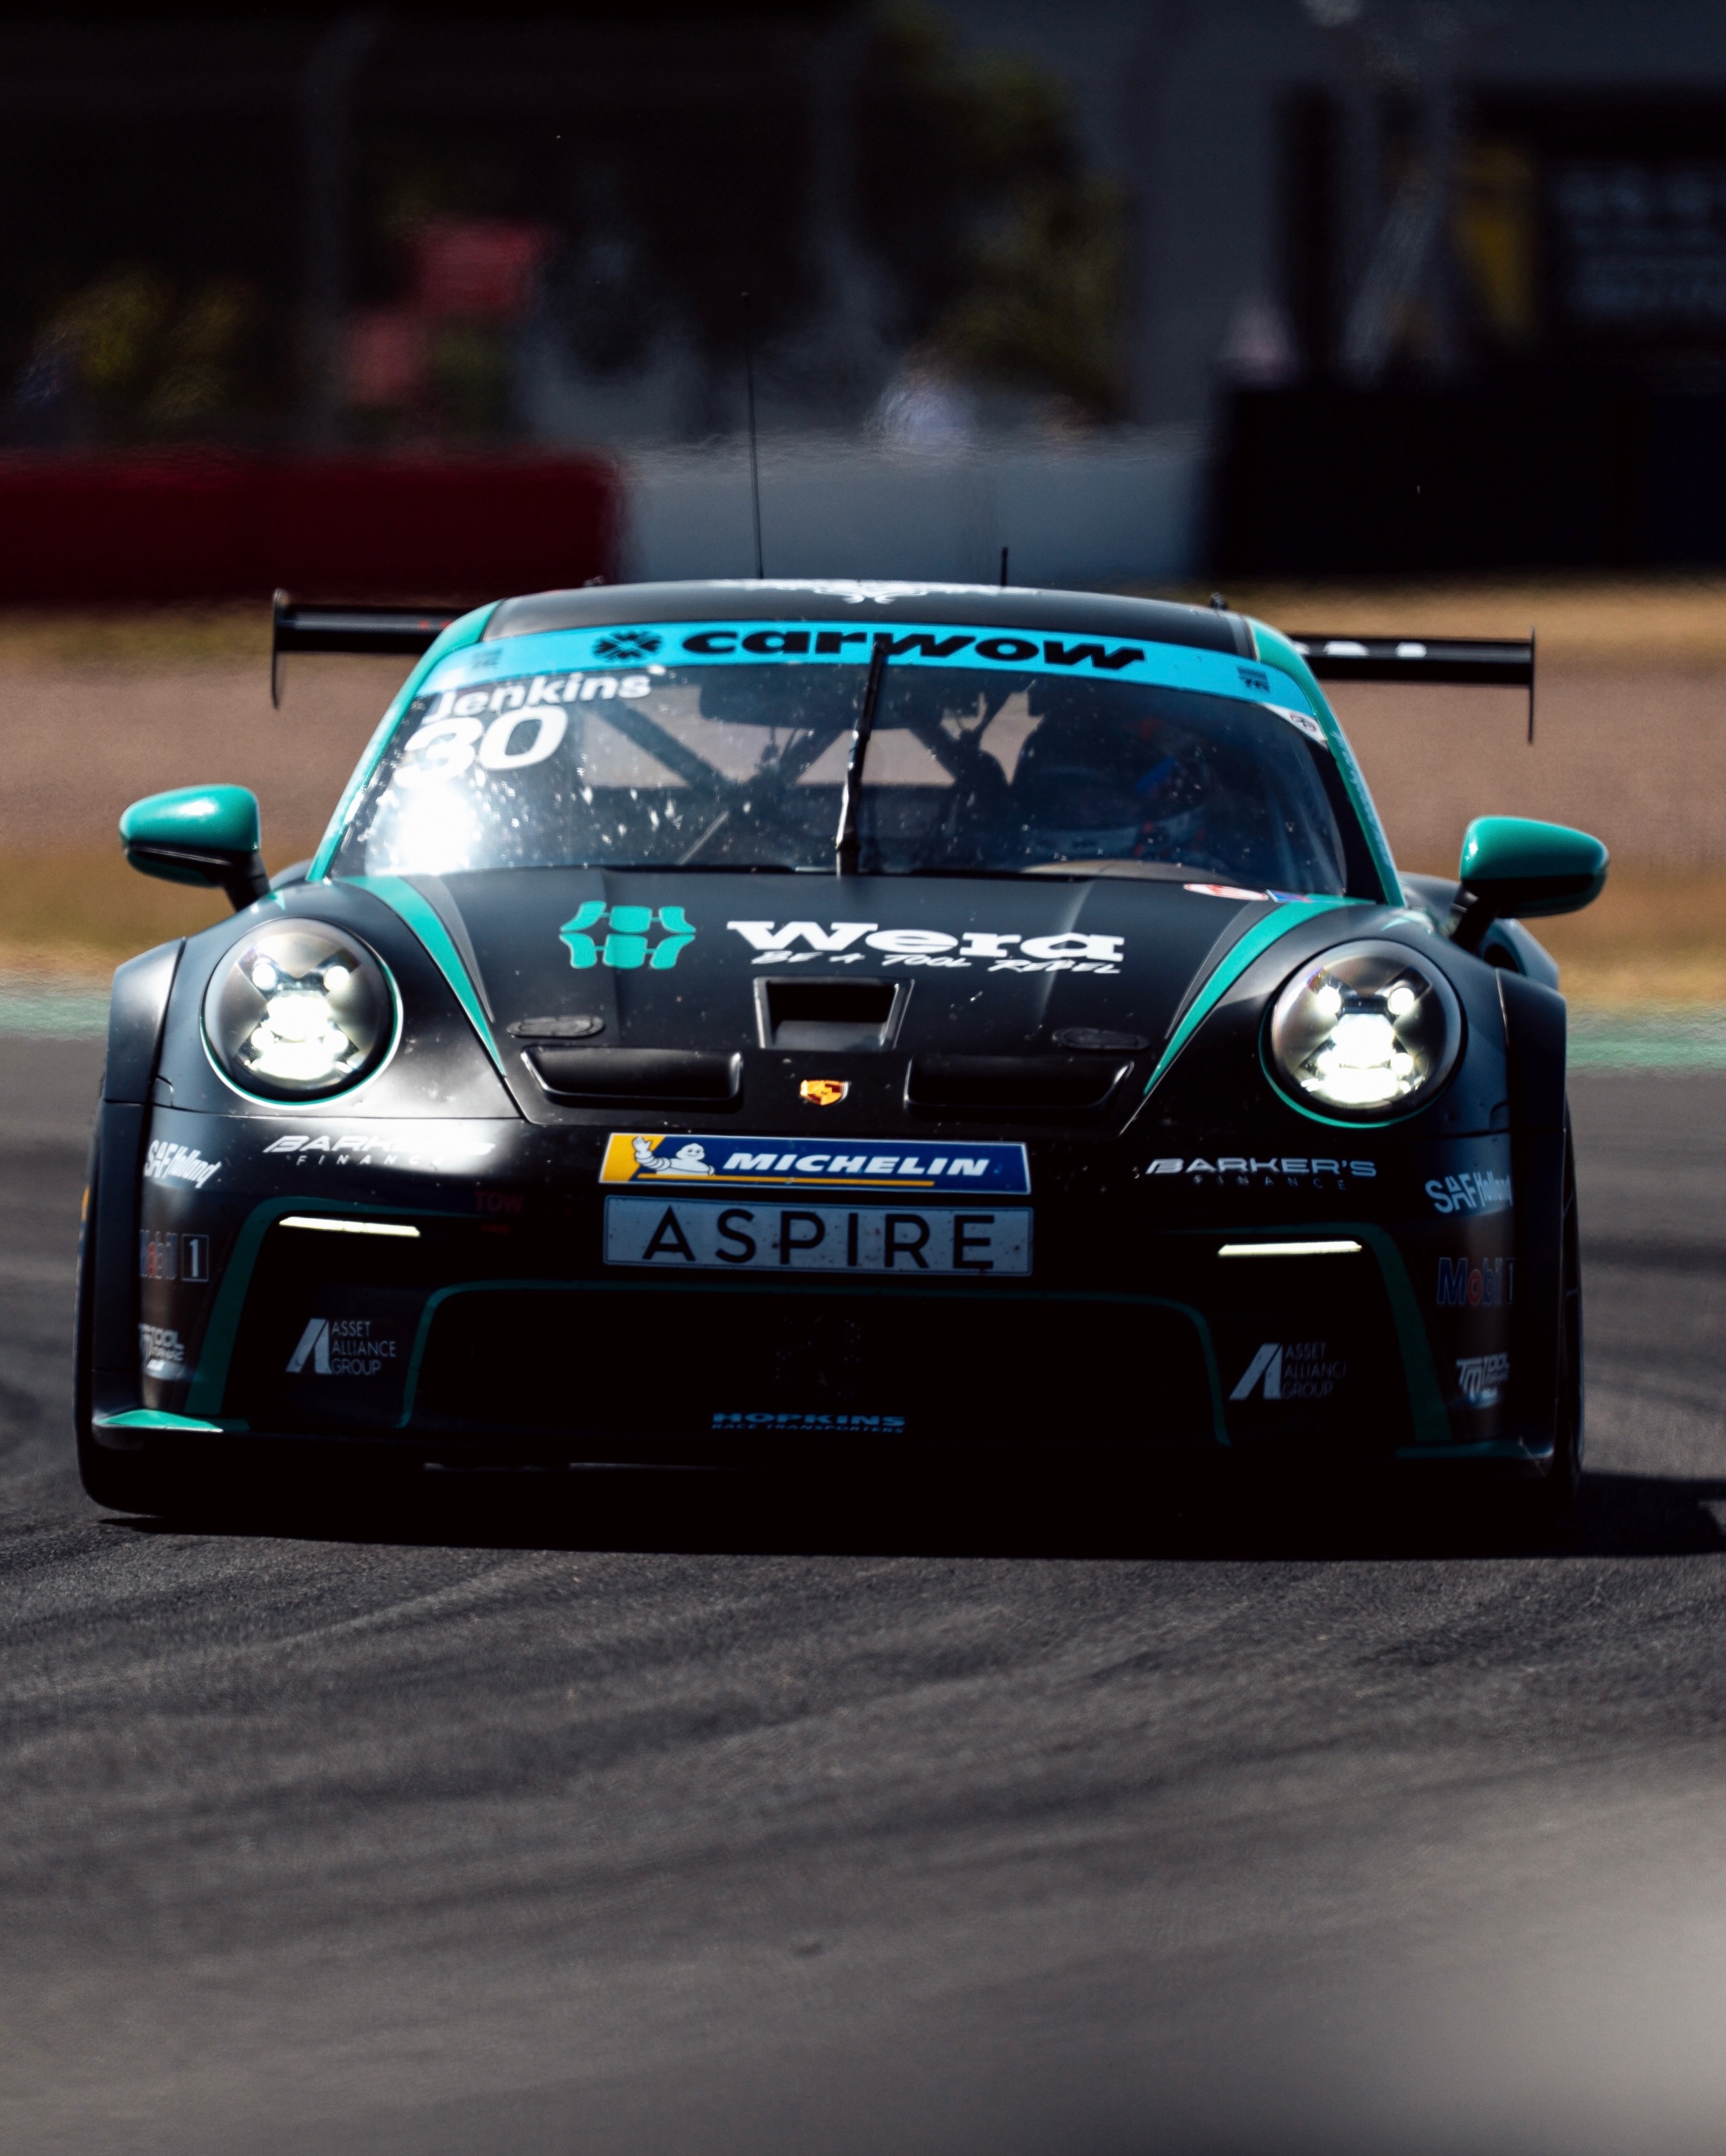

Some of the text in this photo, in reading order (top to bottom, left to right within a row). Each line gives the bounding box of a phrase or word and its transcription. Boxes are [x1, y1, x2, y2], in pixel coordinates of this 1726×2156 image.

[683, 629, 1145, 671] carwow
[422, 673, 651, 724] Jenkins
[393, 704, 568, 788] 30
[727, 921, 1124, 962] Wera
[751, 950, 1121, 974] BE A TOOL REBEL
[262, 1135, 496, 1155] BARKS
[723, 1152, 990, 1176] MICHELIN
[1145, 1158, 1377, 1177] BARKER'S
[1193, 1175, 1347, 1190] FINANCE
[475, 1189, 526, 1212] TOW
[642, 1206, 996, 1269] ASPIRE
[139, 1229, 178, 1280] Mobil
[1437, 1257, 1503, 1306] Mobil
[331, 1320, 371, 1337] ASSET
[331, 1340, 397, 1357] ALLIANCE
[1284, 1341, 1327, 1360] ASSET
[331, 1358, 382, 1375] GROUP
[1282, 1380, 1334, 1399] GROUP
[712, 1412, 906, 1426] HOPKINS
